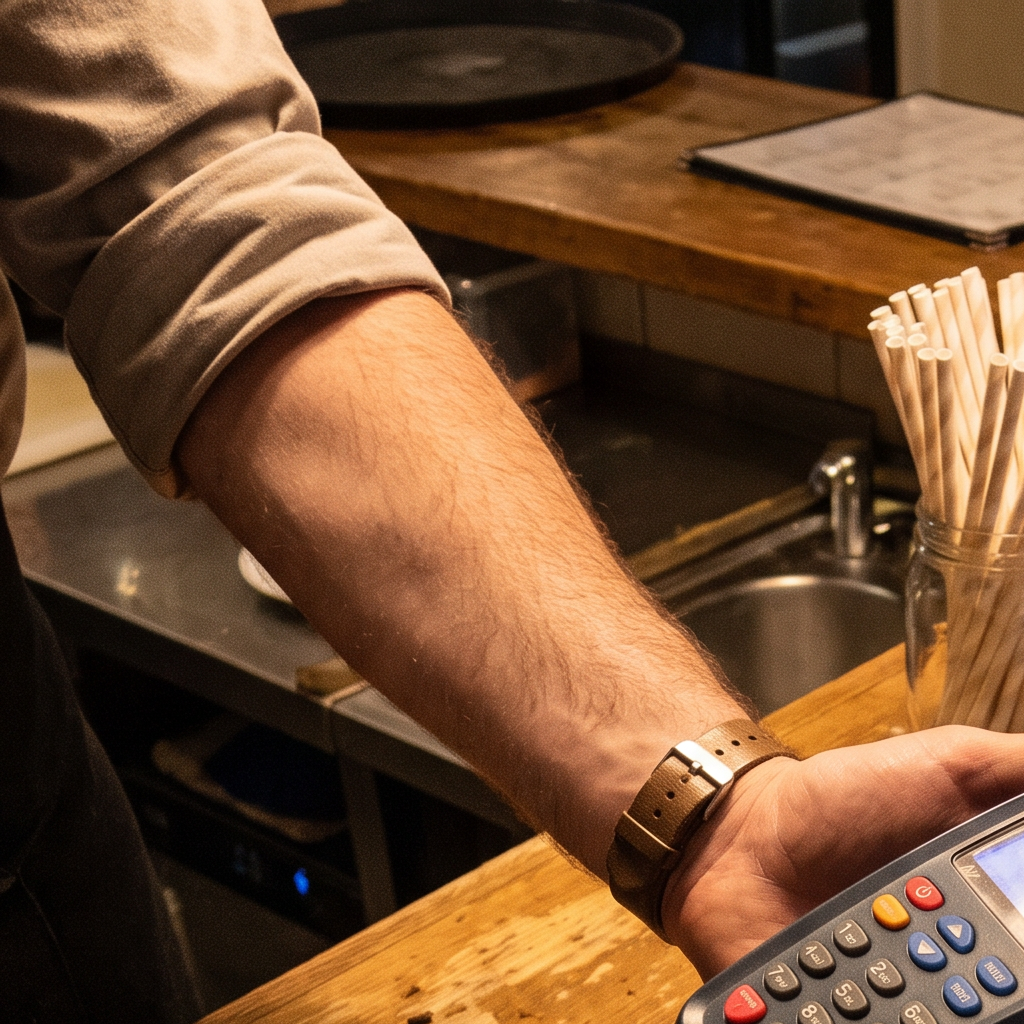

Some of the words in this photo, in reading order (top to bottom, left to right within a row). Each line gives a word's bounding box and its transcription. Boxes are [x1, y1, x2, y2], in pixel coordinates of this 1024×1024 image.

[839, 922, 852, 934] 1
[767, 964, 784, 976] 7
[869, 961, 887, 975] 2
[835, 983, 852, 997] 5
[801, 1004, 817, 1019] 8
[904, 1004, 921, 1019] 6
